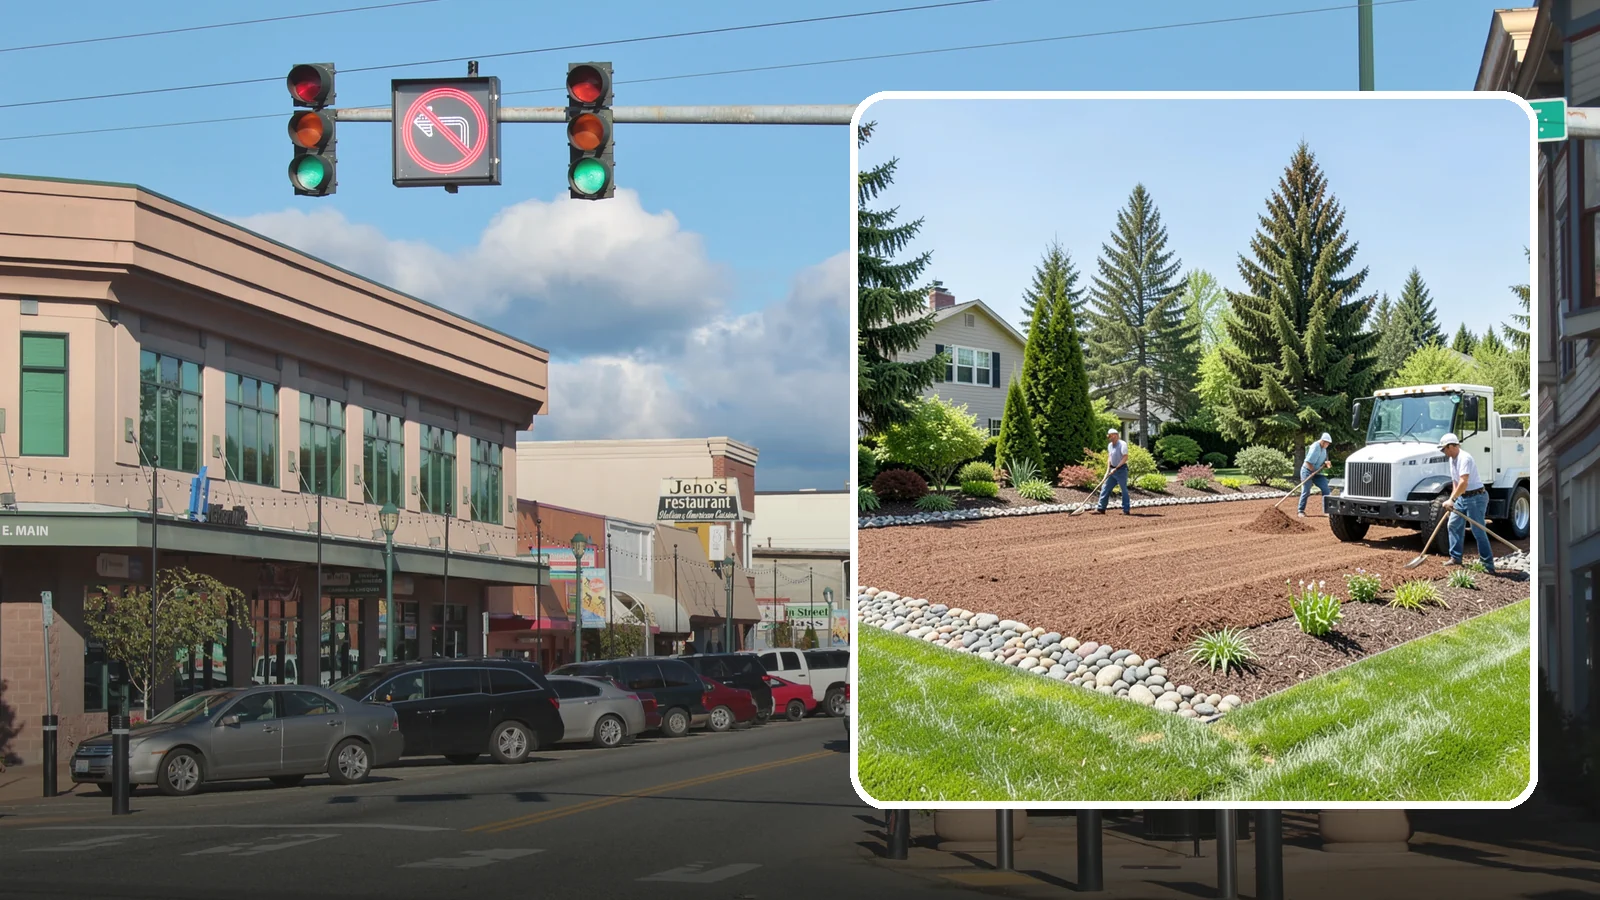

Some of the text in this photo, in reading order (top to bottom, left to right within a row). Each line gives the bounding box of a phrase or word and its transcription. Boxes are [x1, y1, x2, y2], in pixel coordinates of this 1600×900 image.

[669, 480, 727, 494] Jeno's
[665, 496, 731, 509] restaurant
[686, 510, 715, 519] American
[715, 509, 737, 519] Cuisine
[2, 525, 49, 536] E. MAIN
[797, 607, 828, 616] Street
